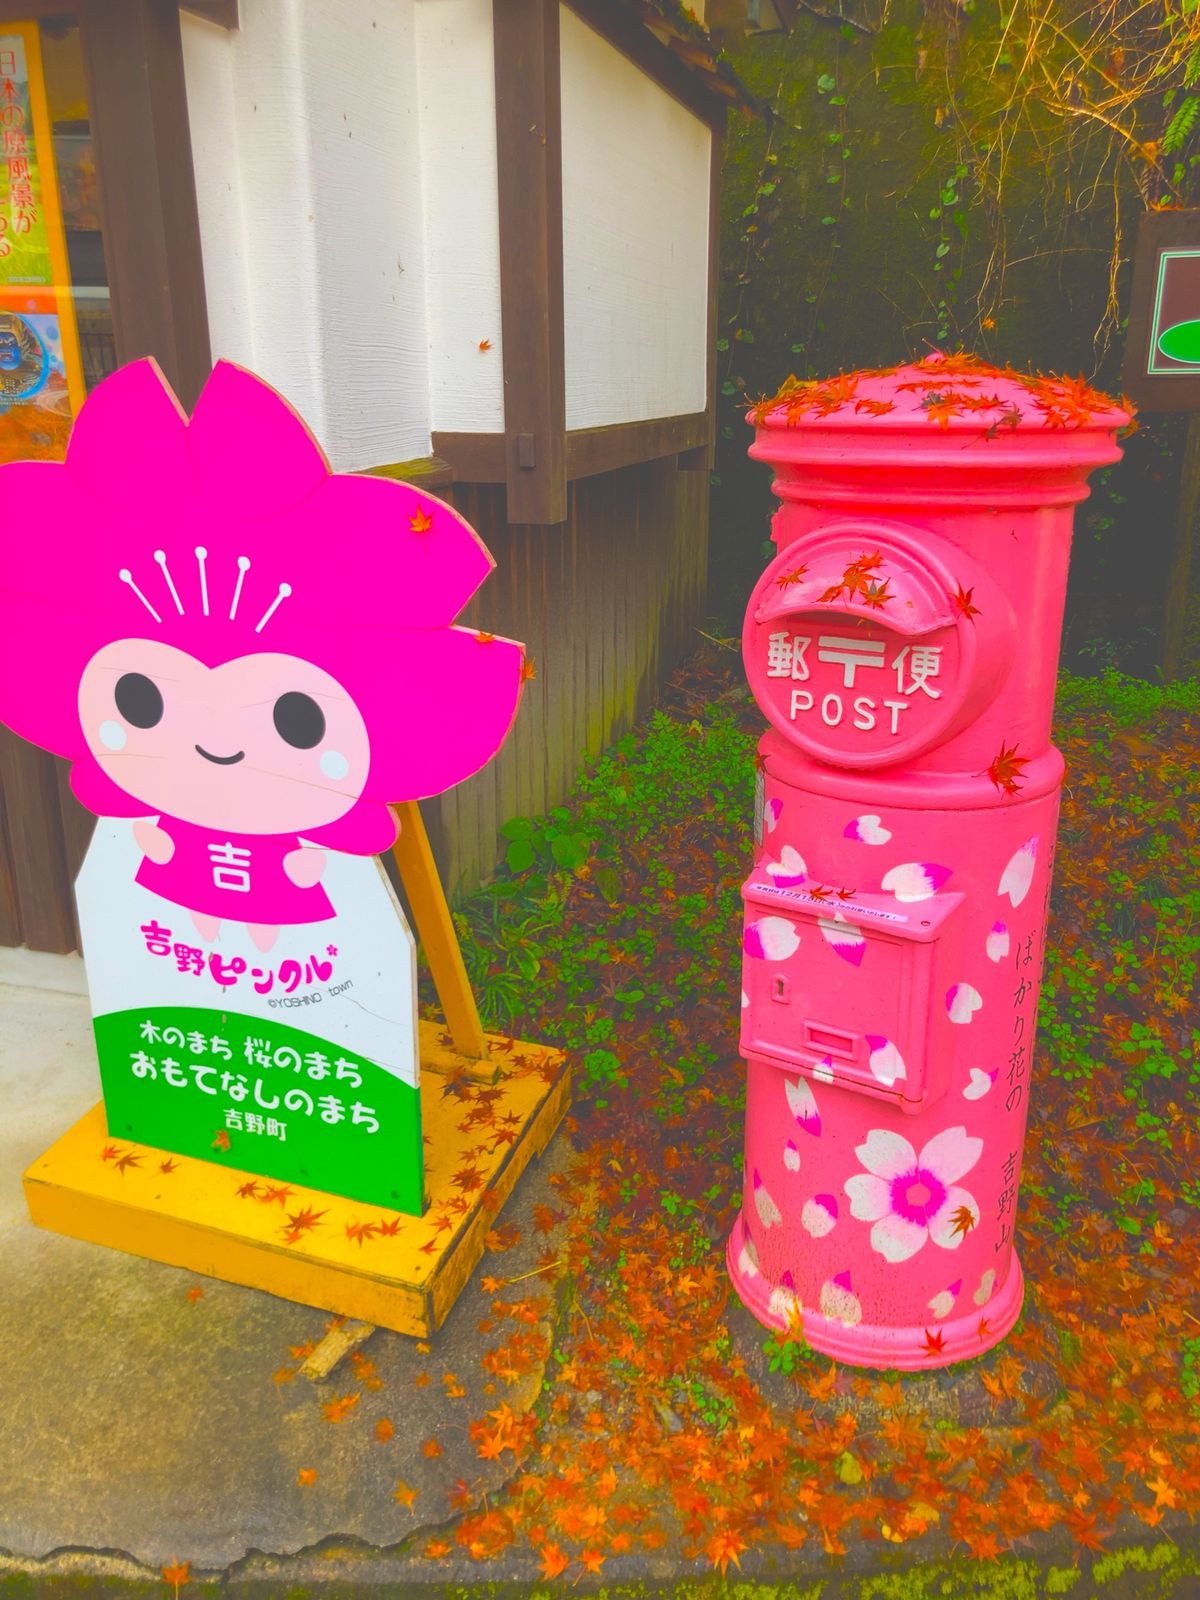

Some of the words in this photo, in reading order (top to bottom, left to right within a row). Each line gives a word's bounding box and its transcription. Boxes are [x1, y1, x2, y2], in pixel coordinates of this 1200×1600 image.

[790, 690, 909, 735] POST
[207, 841, 252, 894] 吉
[140, 919, 333, 994] 吉野ピンクル
[328, 979, 354, 997] town
[138, 1019, 233, 1061] 木のまち
[243, 1035, 363, 1088] 桜のまち
[128, 1050, 381, 1134] おもてなしのまち
[222, 1107, 288, 1142] 吉野町
